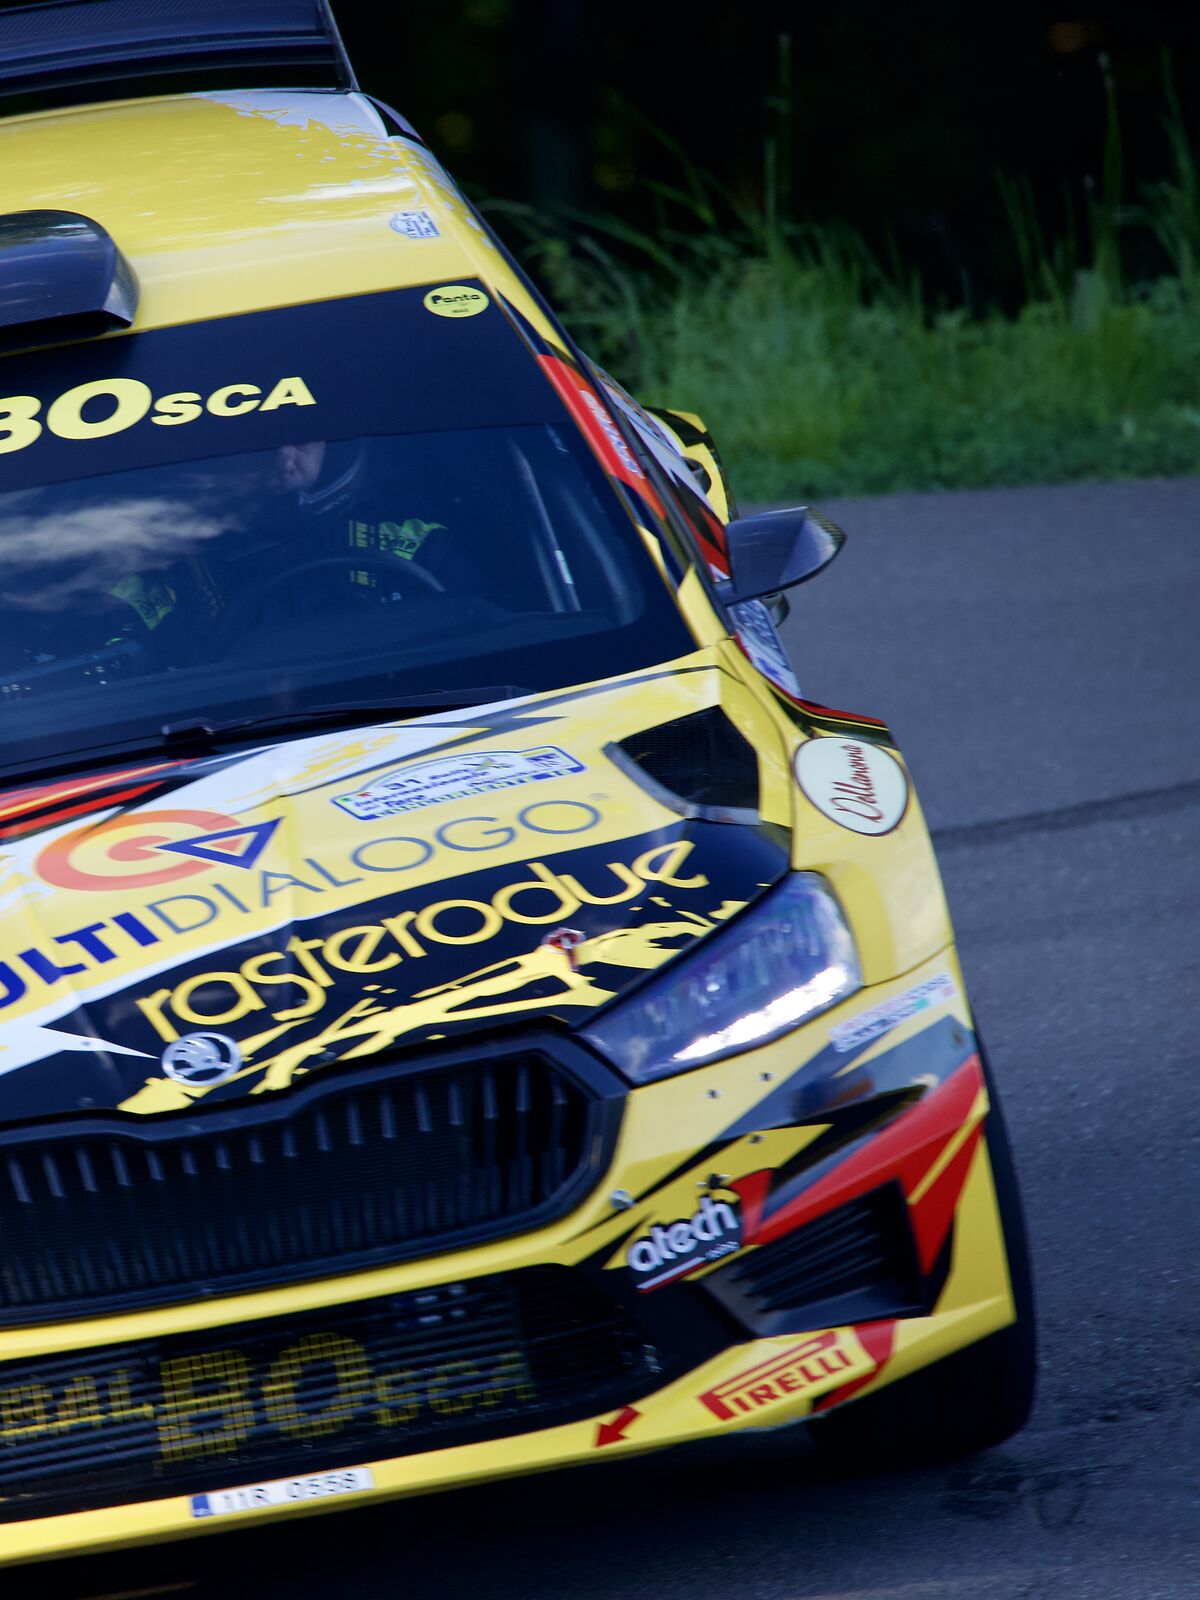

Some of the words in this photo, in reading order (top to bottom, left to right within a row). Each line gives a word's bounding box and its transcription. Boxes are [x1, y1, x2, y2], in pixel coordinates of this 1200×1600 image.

[136, 840, 709, 1042] rasterodue
[627, 1196, 740, 1272] atech
[697, 1330, 854, 1422] PIRELLI
